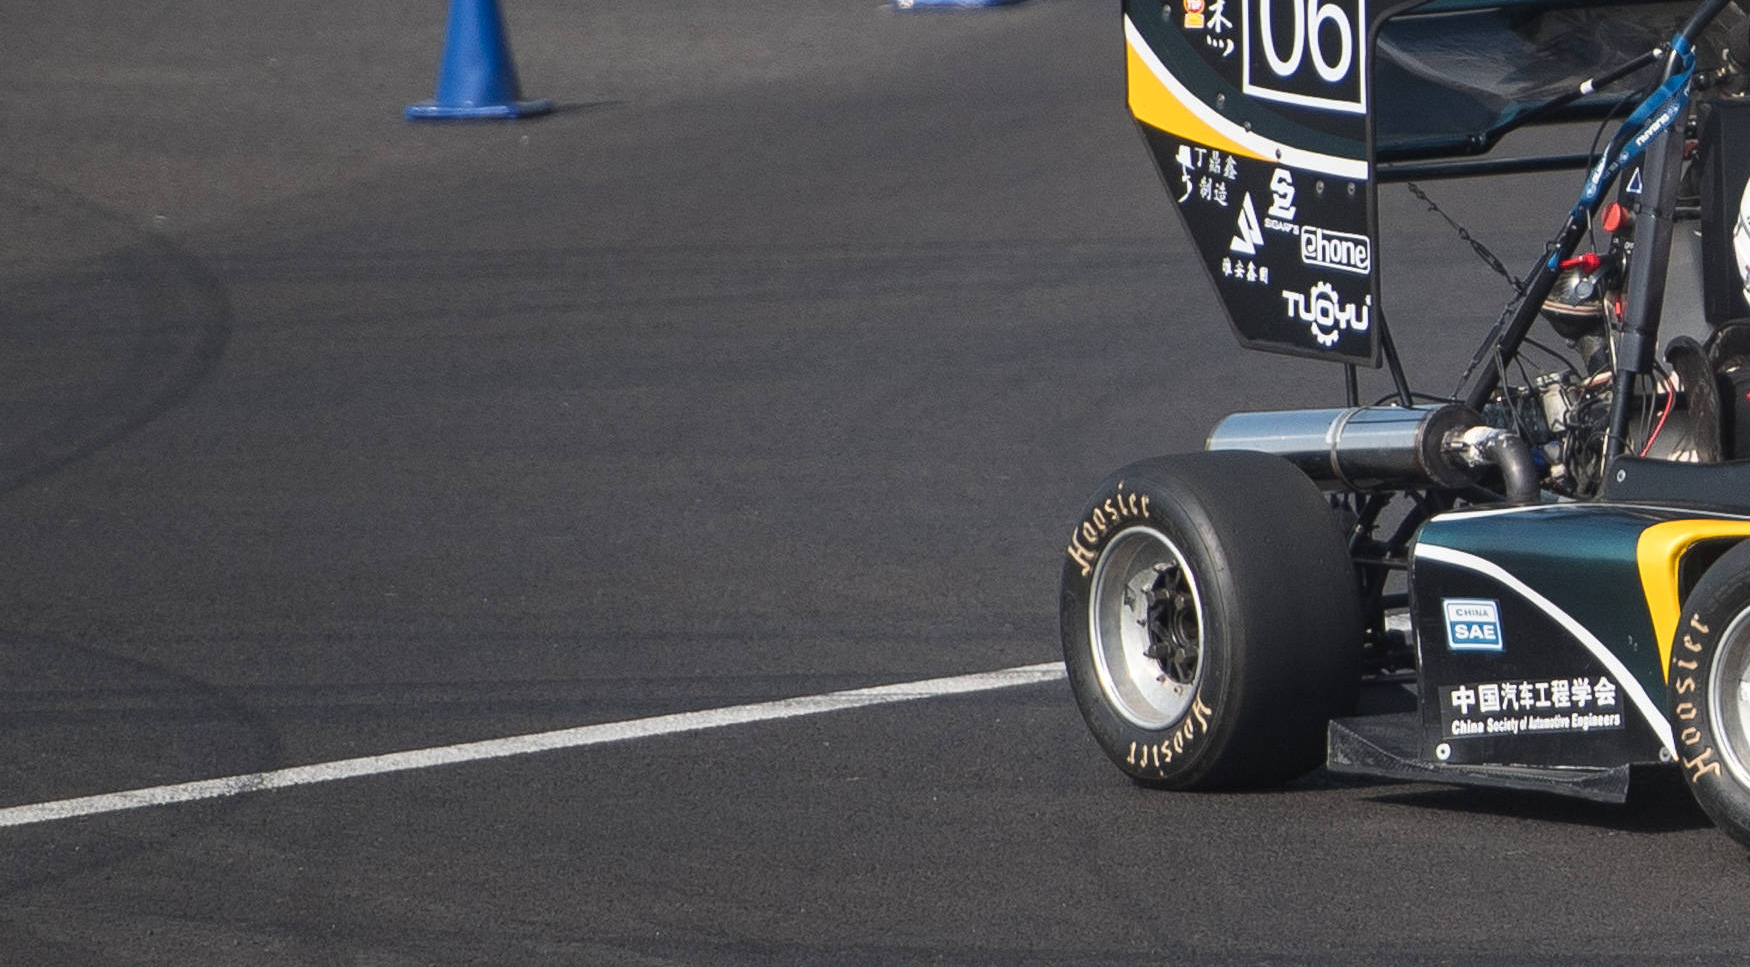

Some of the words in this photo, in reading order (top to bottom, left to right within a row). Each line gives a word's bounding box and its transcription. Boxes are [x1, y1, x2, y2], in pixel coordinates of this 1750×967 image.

[1282, 289, 1369, 331] TUOYU
[1455, 608, 1490, 617] CHINA
[1454, 623, 1497, 640] SAE
[1451, 676, 1616, 715] 中国汽车工程学会
[1672, 612, 1722, 783] Hoosier
[1451, 719, 1484, 734] China
[1486, 717, 1519, 734] Society
[1519, 715, 1527, 730] of
[1571, 712, 1620, 731] Engineers
